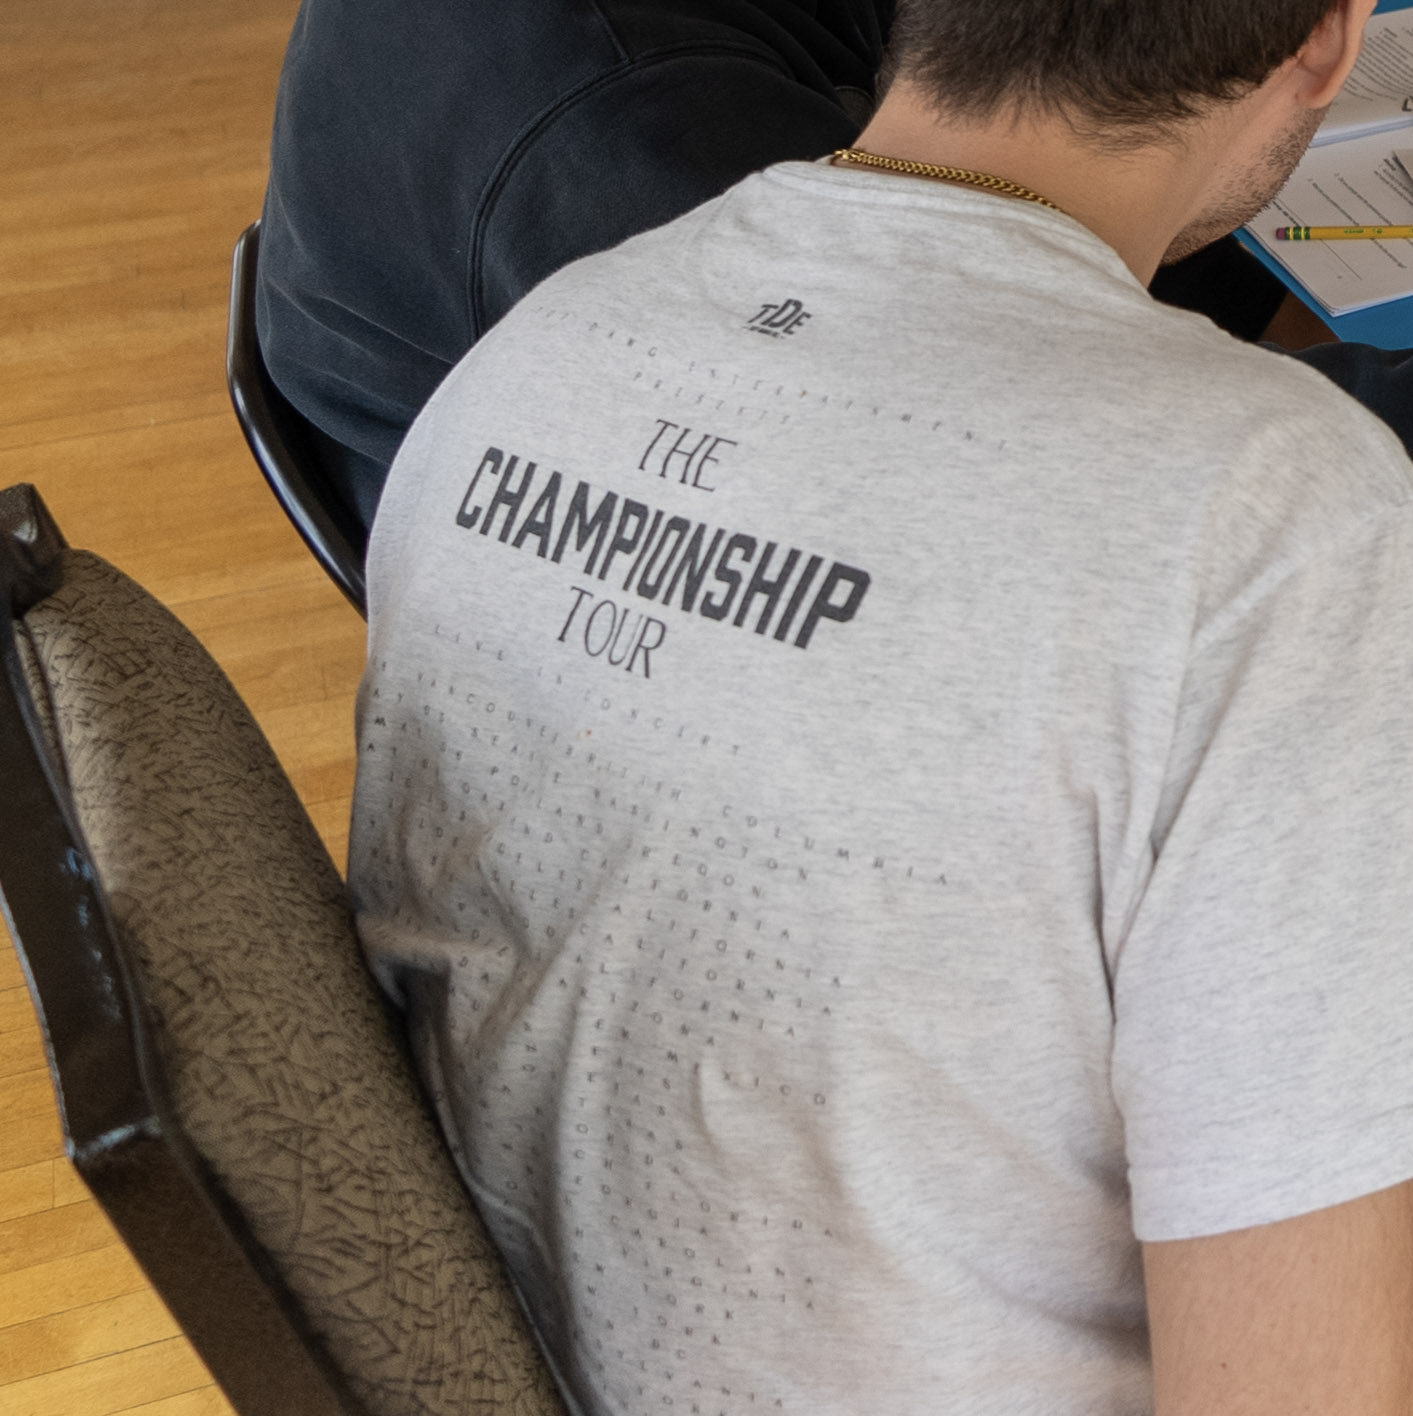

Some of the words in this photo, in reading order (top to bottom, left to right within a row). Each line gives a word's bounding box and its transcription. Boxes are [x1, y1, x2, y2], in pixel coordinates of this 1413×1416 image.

[638, 418, 739, 493] THE
[455, 446, 872, 651] CHAMPIONSHIP
[557, 585, 668, 680] TOUR
